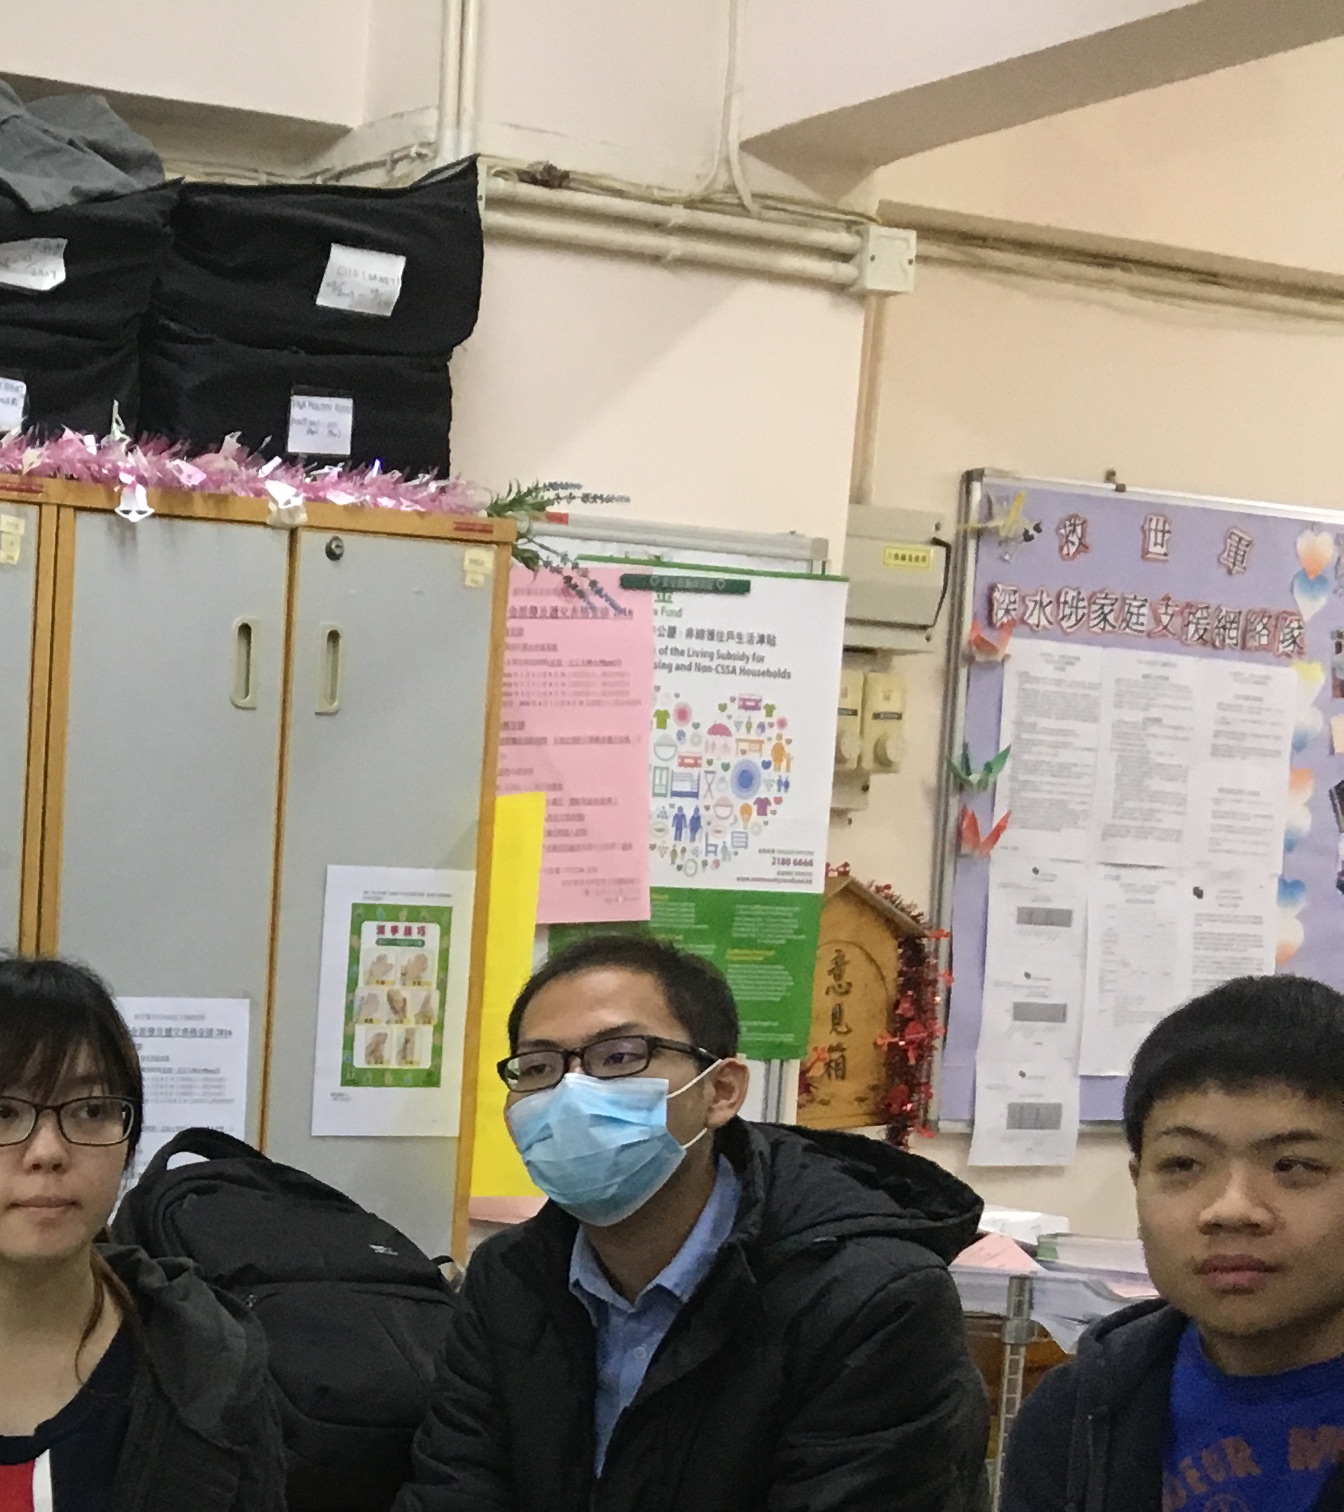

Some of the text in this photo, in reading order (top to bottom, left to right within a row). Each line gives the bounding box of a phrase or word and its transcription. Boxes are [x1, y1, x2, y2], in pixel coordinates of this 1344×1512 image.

[1057, 514, 1254, 577] 救世軍
[661, 606, 683, 619] Fund
[658, 645, 765, 665] of the Living Subsidy for
[675, 662, 692, 674] and
[694, 663, 737, 677] Non-CSSA
[739, 665, 792, 681] Households
[823, 947, 853, 1081] 意見箱
